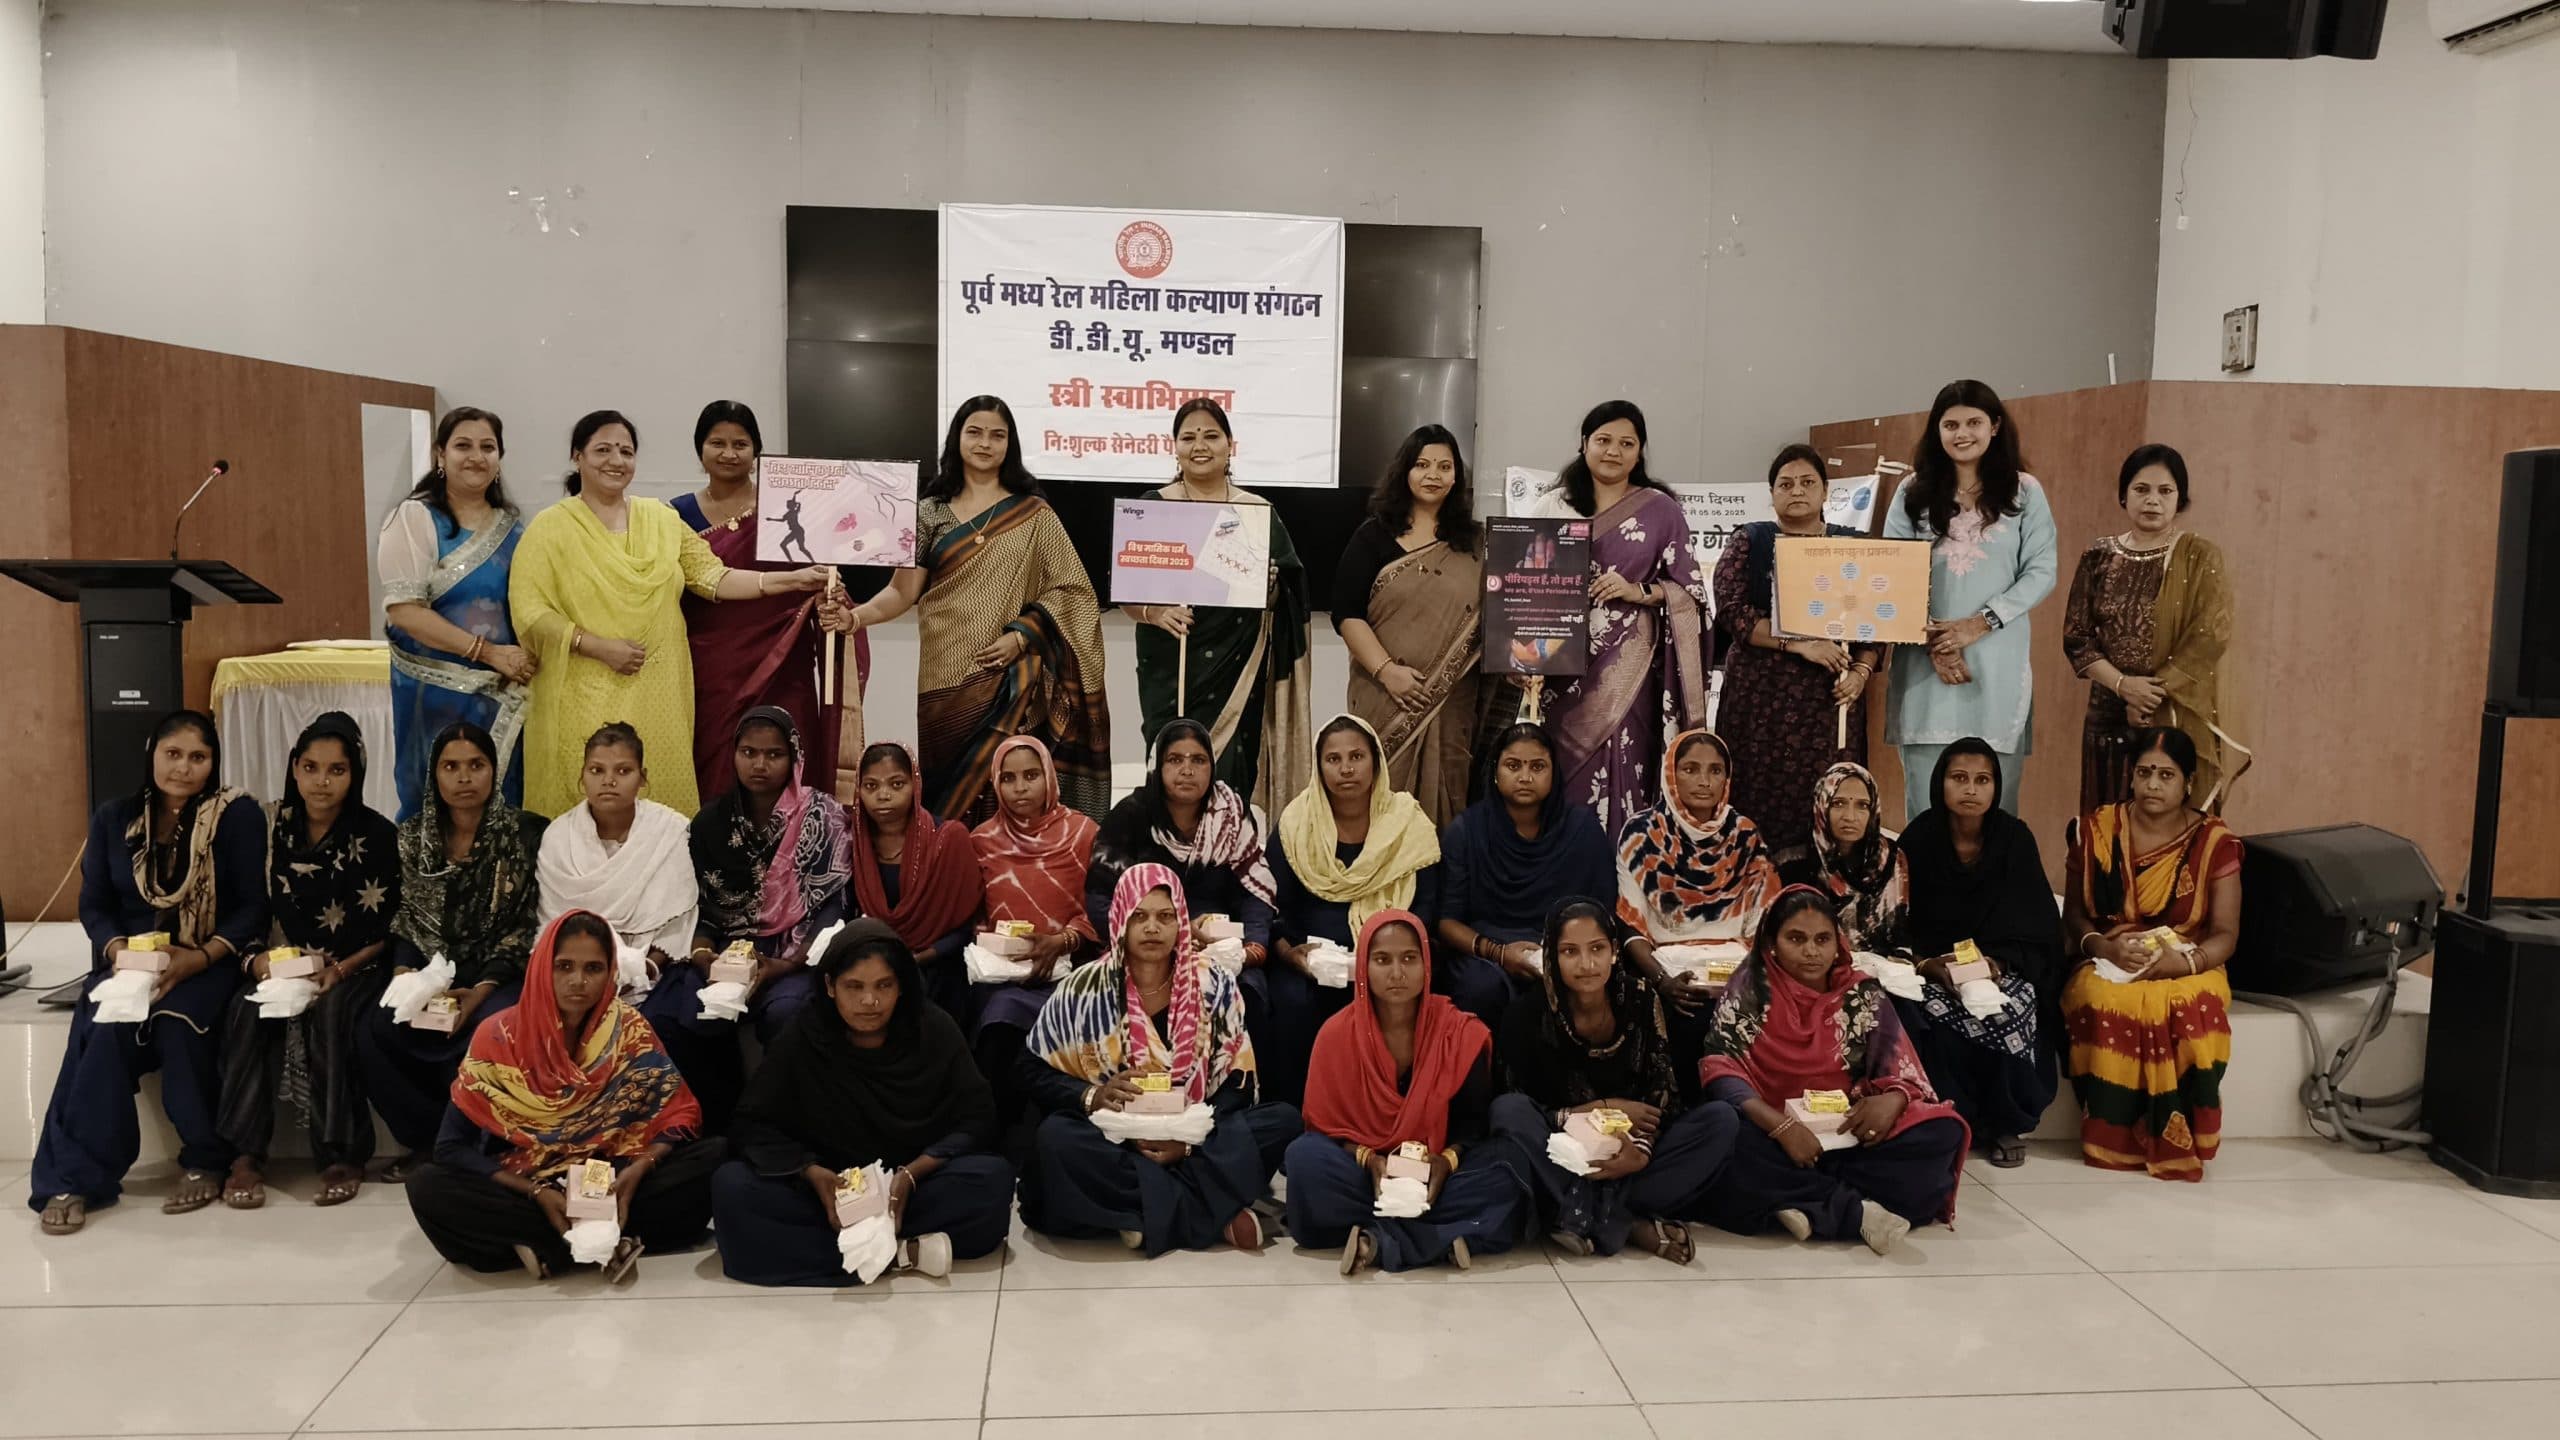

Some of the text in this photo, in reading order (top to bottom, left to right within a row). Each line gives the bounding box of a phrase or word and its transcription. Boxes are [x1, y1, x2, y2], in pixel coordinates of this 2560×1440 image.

[961, 273, 1323, 317] पूर्व मध्य रेल महिला कल्याण संगठन
[1160, 331, 1236, 355] मण्डल
[1048, 377, 1094, 409] स्त्री
[1111, 432, 1160, 455] सेनेटरी
[1707, 492, 1746, 505] दिवस
[1122, 506, 1145, 516] Wings
[1169, 558, 1190, 566] 2025
